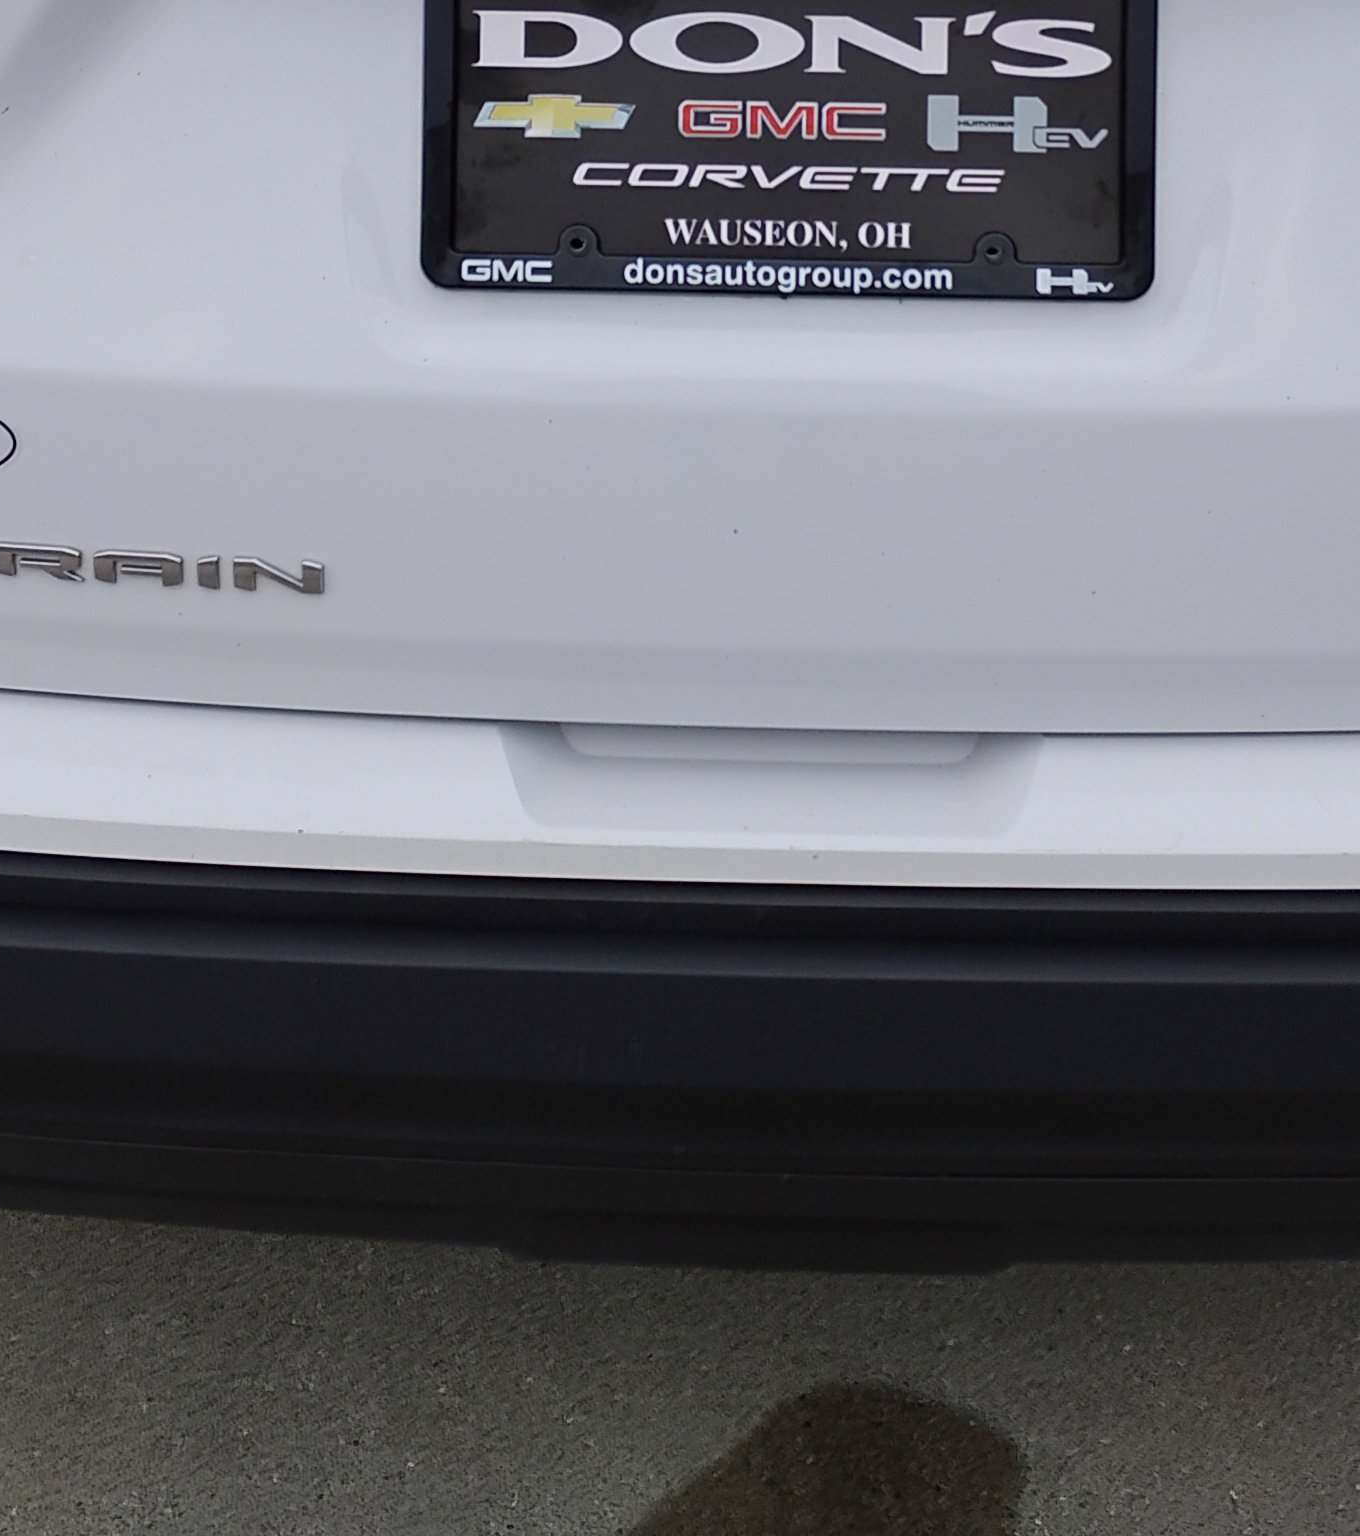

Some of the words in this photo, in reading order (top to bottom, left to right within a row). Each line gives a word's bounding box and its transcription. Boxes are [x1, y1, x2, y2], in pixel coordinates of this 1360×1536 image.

[470, 9, 1113, 79] DON'S
[678, 99, 887, 141] GMC
[572, 162, 1005, 193] CORVETTE
[663, 218, 848, 252] WAUSEON,
[857, 221, 912, 250] OH
[461, 259, 554, 283] GMC
[623, 257, 954, 294] donsautogroup.com
